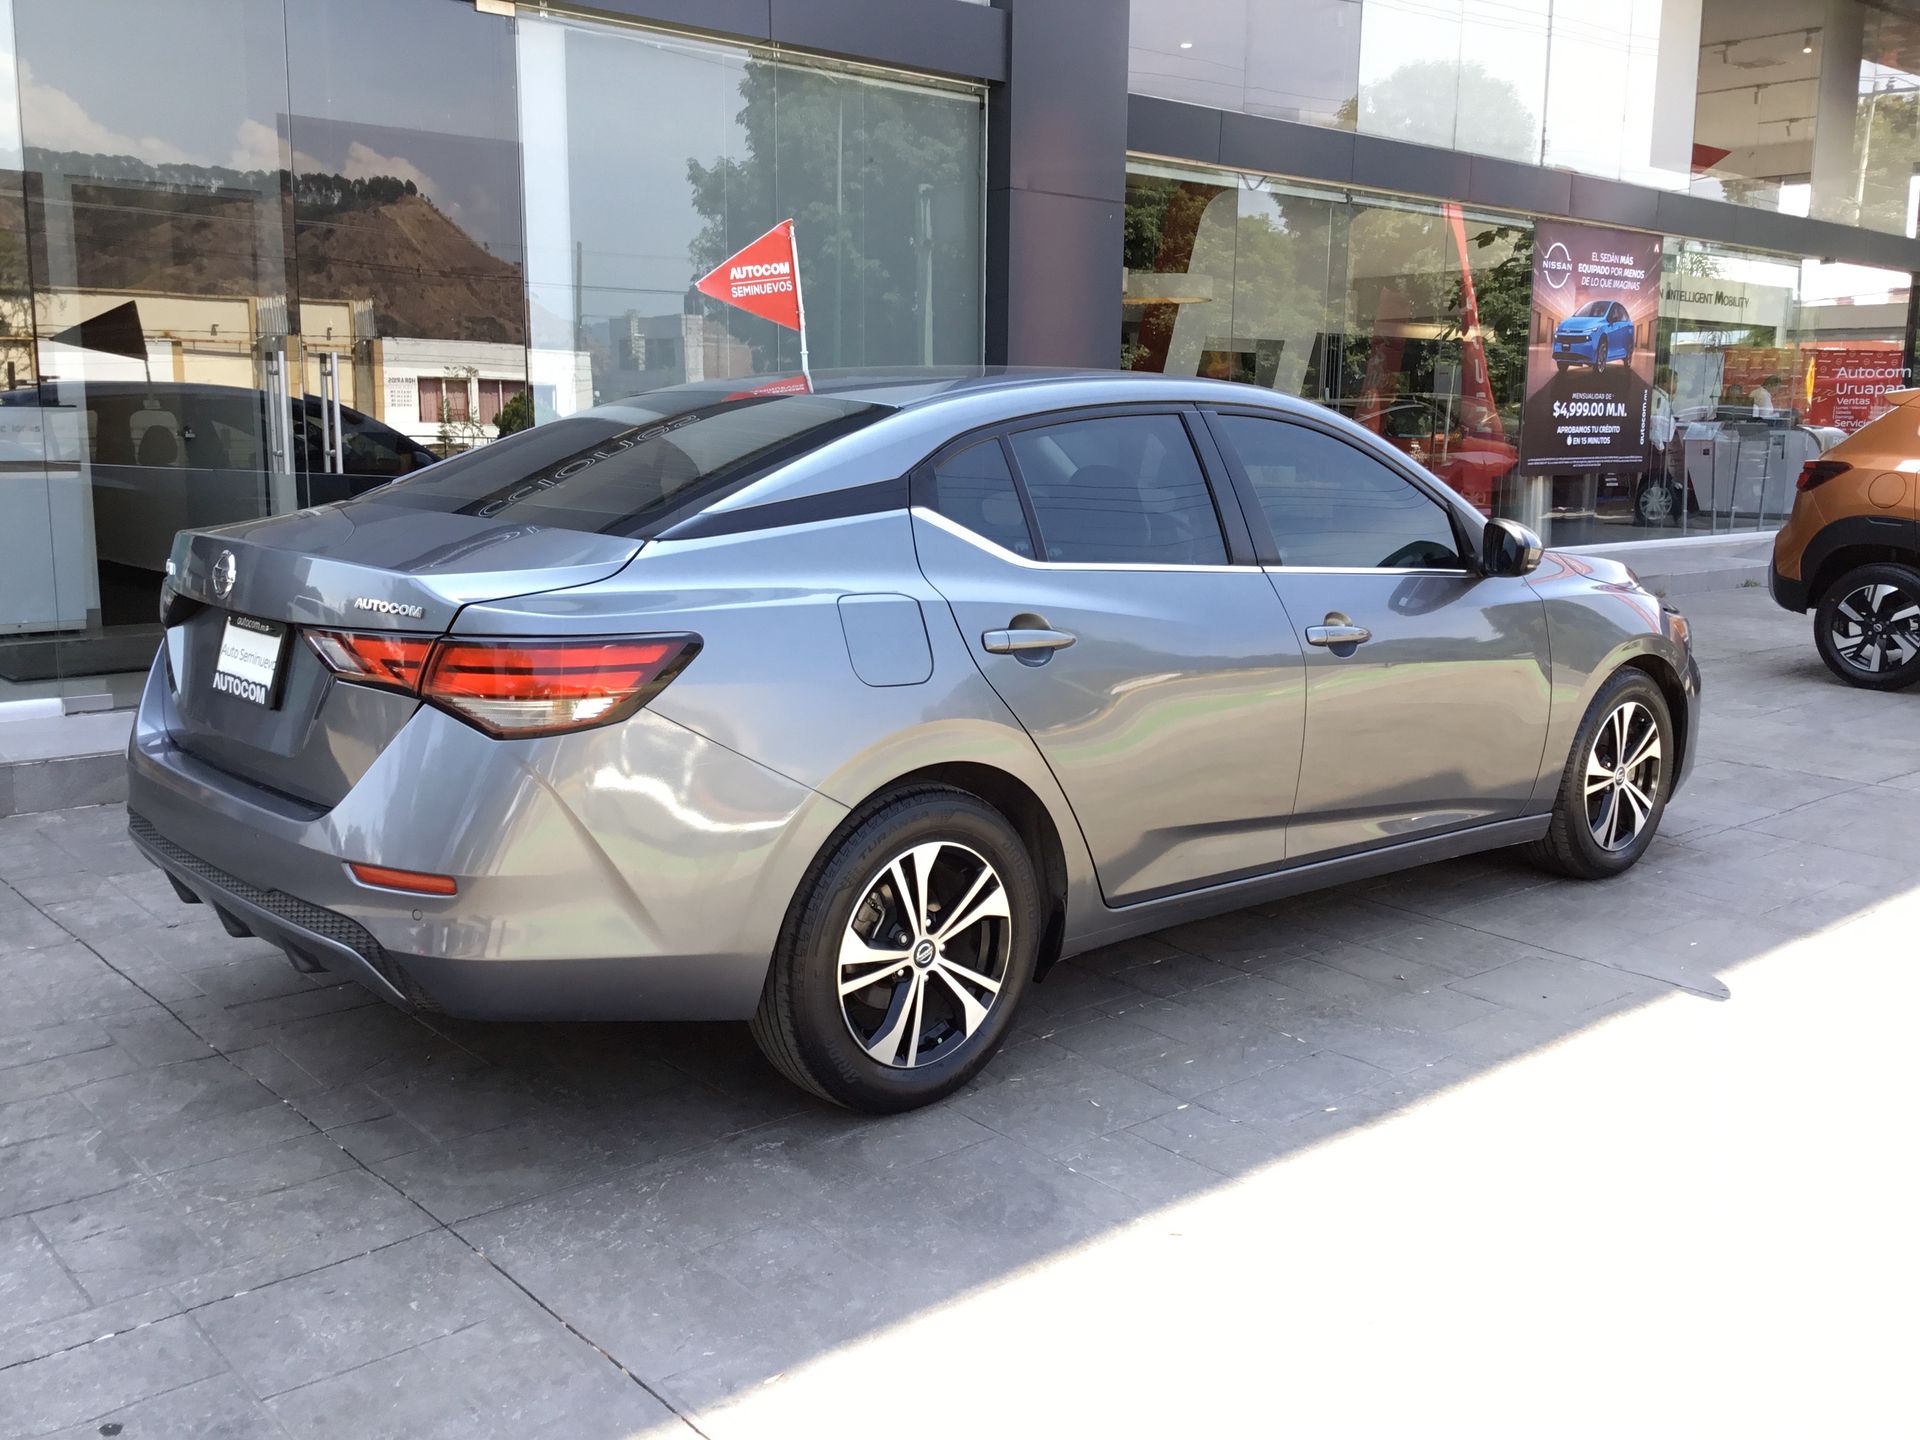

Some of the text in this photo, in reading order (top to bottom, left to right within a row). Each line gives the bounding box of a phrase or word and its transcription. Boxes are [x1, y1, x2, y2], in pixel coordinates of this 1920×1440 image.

[1542, 260, 1572, 271] NISSAN
[1591, 252, 1634, 265] EL SEDÁN MÁS
[730, 262, 790, 280] AUTOCOM
[1578, 264, 1645, 279] EQUIPADO POR MENOS
[731, 280, 793, 298] SEMINUEVOS
[1581, 277, 1640, 291] DE LO QUE IMAGINAS
[1666, 286, 1713, 304] INTELLIGENT
[1714, 290, 1750, 308] MOBILITY
[1836, 366, 1912, 379] Autocom
[1836, 397, 1871, 405] Ventas
[1552, 400, 1627, 419] $4,999.00 M.N.
[1557, 424, 1620, 434] APROBAMOS TU CRÉDITO
[1573, 437, 1581, 445] EN
[1587, 436, 1611, 445] MINUTOS
[354, 597, 424, 618] AUTOCOM
[221, 643, 239, 659] Auto
[212, 672, 266, 705] AUTOCOM
